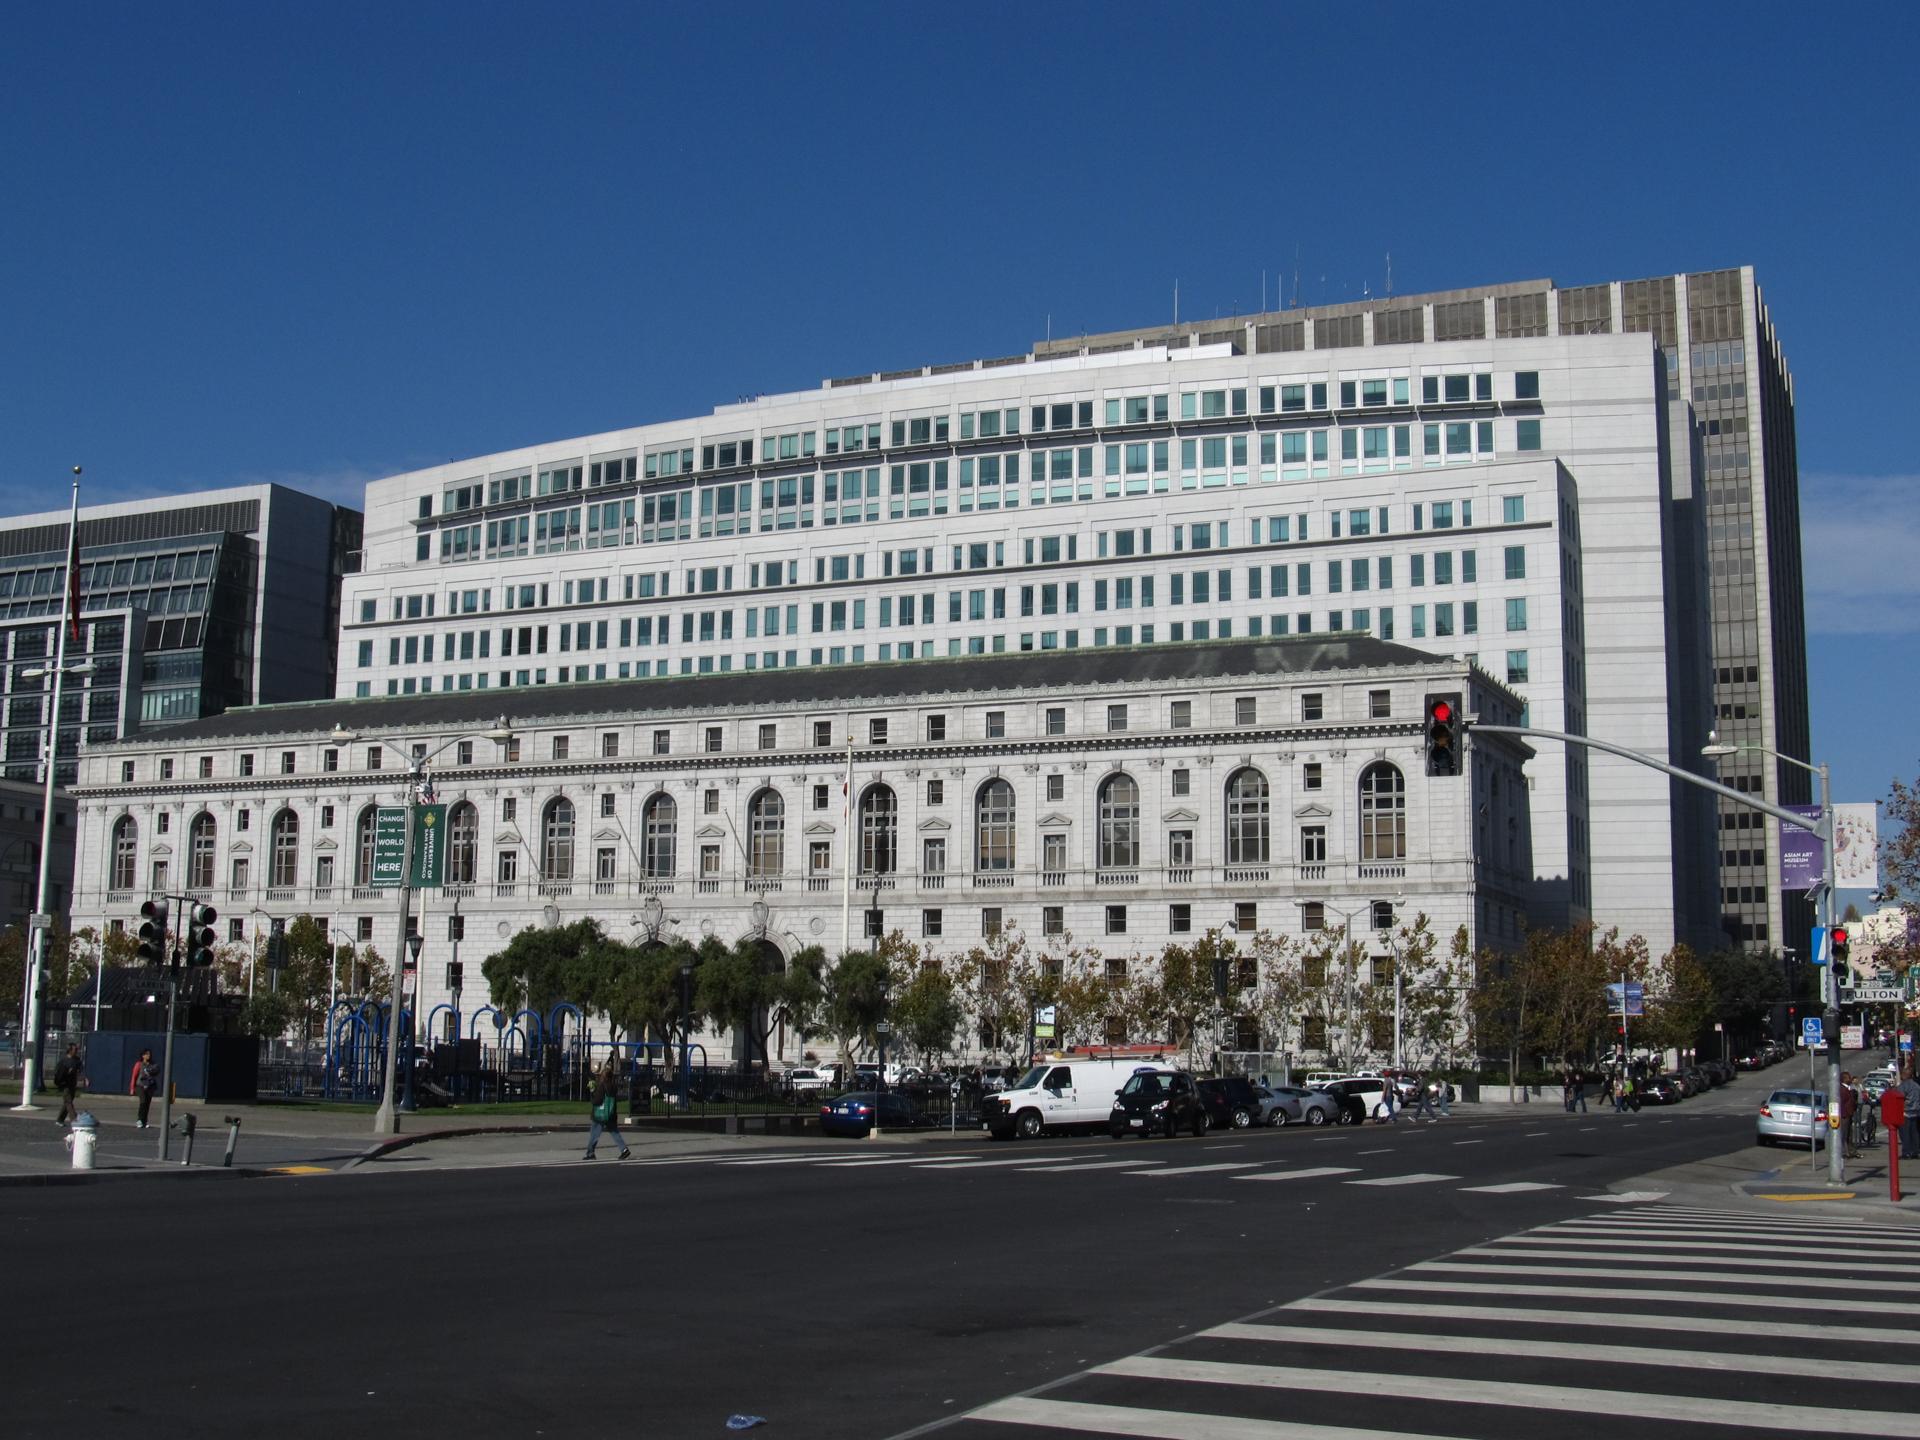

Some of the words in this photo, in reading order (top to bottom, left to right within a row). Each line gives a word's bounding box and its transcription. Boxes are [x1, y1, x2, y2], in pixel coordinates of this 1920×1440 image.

[377, 863, 400, 871] HERE
[427, 870, 432, 879] OF
[1846, 990, 1898, 999] FULTON
